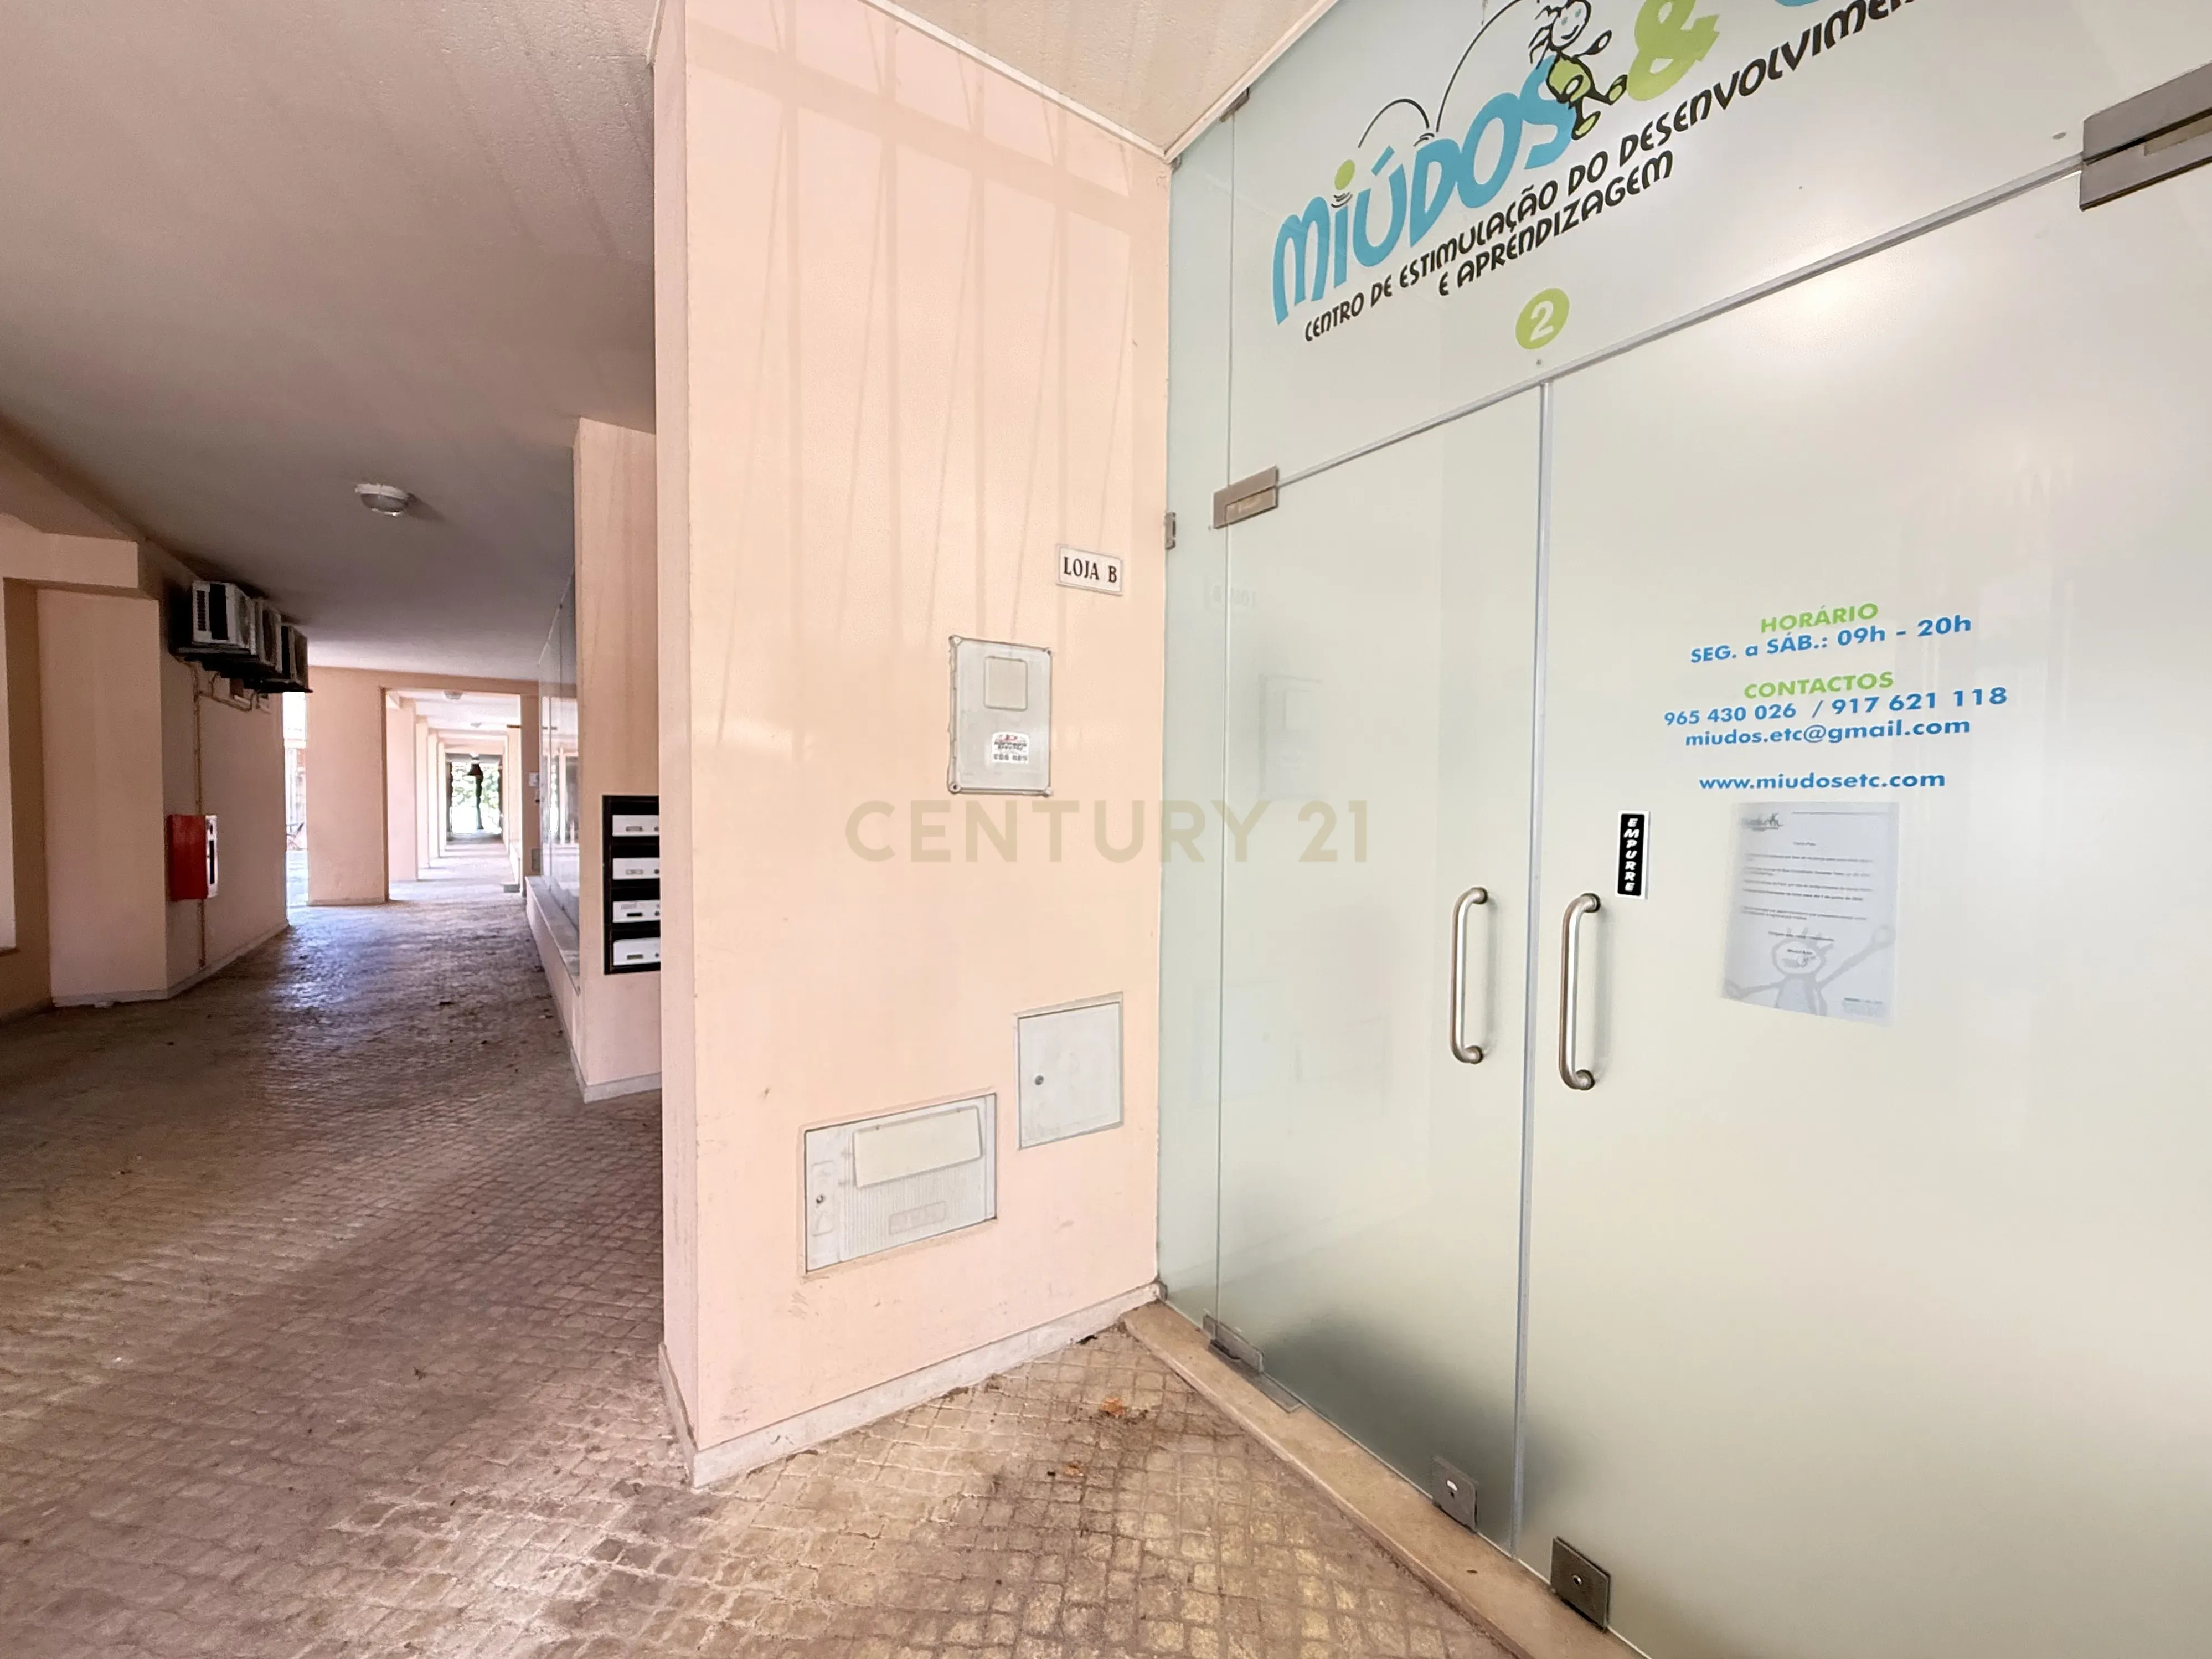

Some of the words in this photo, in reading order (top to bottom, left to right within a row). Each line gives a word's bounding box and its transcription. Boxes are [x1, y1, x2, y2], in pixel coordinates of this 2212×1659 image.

[1272, 54, 1576, 326] MIÚDOS
[1627, 0, 1720, 101] &
[1438, 271, 1450, 296] E
[1457, 150, 1673, 288] APRENDIZAGEM
[1305, 292, 1364, 342] CENTRO
[1370, 274, 1393, 308] DE
[1399, 180, 1558, 288] ESTIMULAÇÃO
[1568, 151, 1608, 196] DO
[1530, 300, 1554, 341] 2
[1063, 556, 1100, 580] LOJA
[1107, 565, 1117, 584] B
[1760, 602, 1879, 633] HORÁRIO
[1690, 646, 1737, 663] SEG.
[1745, 645, 1759, 657] a
[1766, 632, 1828, 655] SÁB.:
[1837, 626, 1886, 647] 09h
[1917, 614, 1972, 637] 20h
[1744, 671, 1894, 699] CONTACTOS
[1664, 709, 1700, 727] 965
[1707, 706, 1747, 723] 430
[1754, 703, 1797, 720] 026
[1831, 696, 1880, 715] 917
[1888, 692, 1937, 711] 621
[1953, 686, 2008, 708] 118
[1685, 719, 1971, 747] miudos.etc@gmail.com
[1699, 772, 1946, 789] www.miudosetc.com
[1623, 818, 1640, 892] EMPURRE
